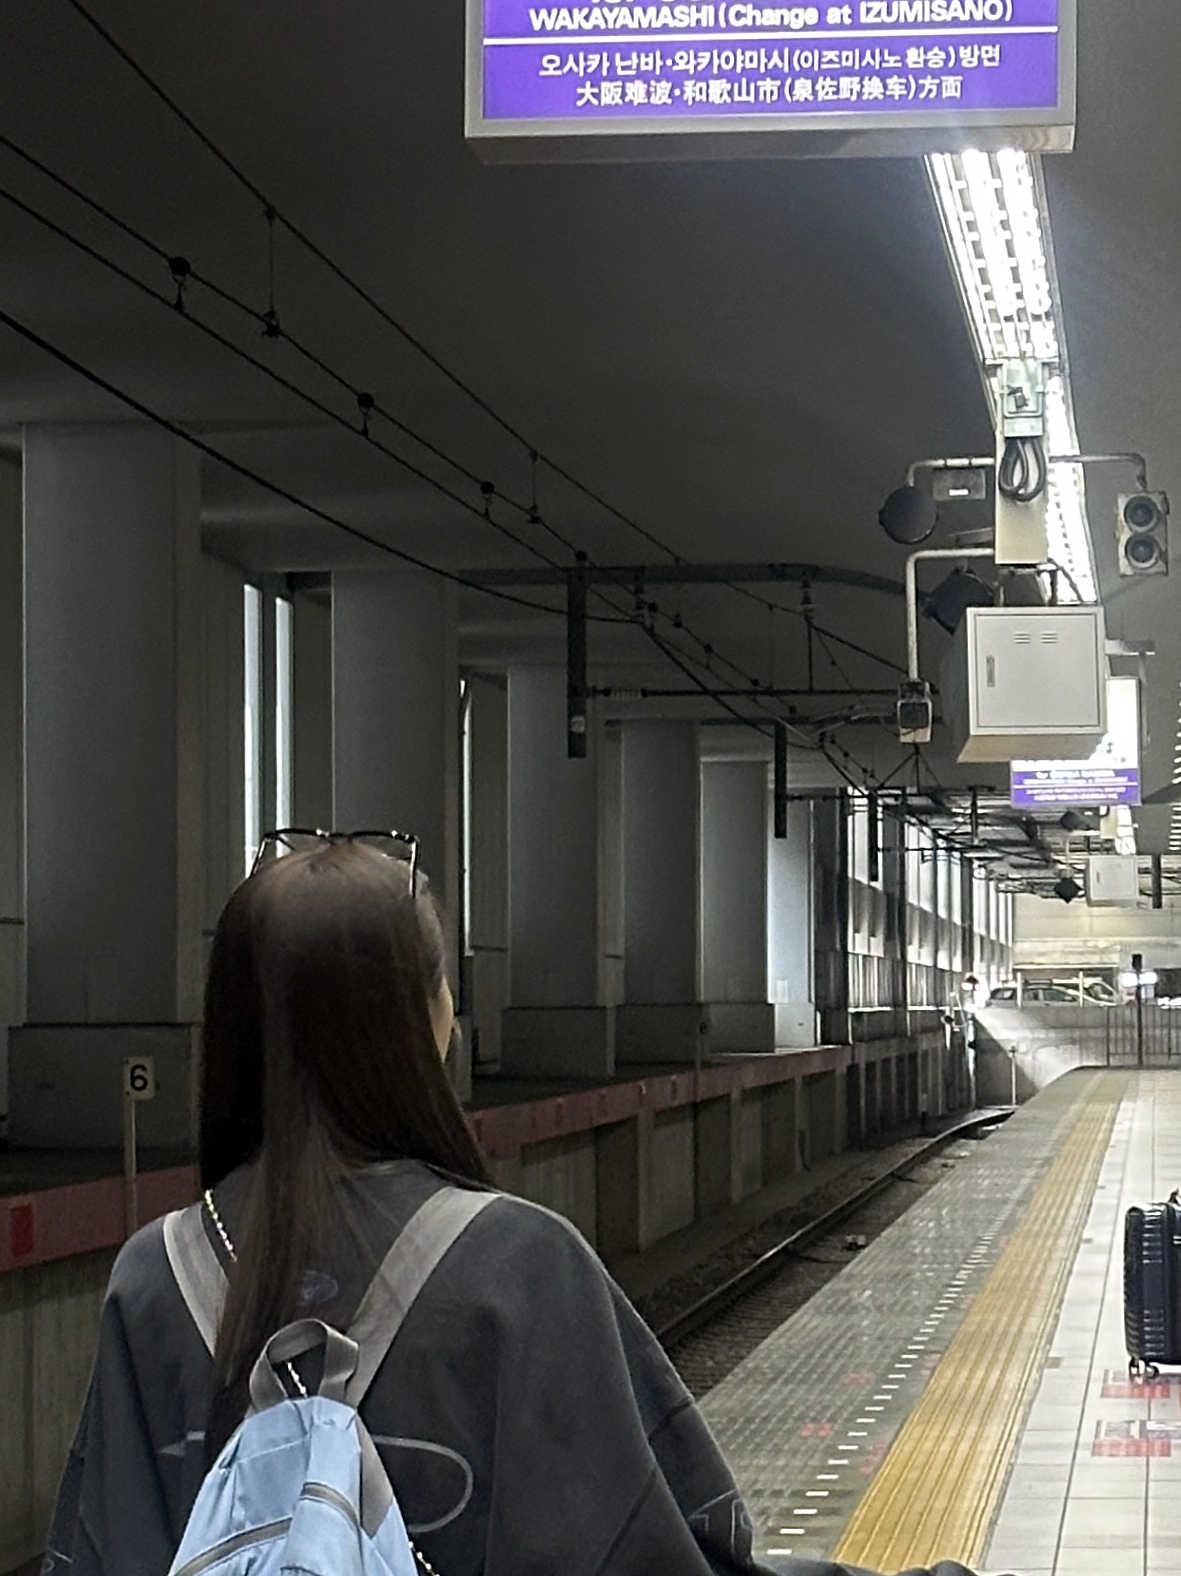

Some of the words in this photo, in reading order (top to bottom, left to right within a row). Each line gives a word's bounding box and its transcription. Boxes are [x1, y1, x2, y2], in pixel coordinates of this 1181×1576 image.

[826, 5, 852, 24] at
[859, 0, 1013, 23] IZUMISANO)
[539, 53, 609, 76] 오사카
[130, 1064, 148, 1091] 6
